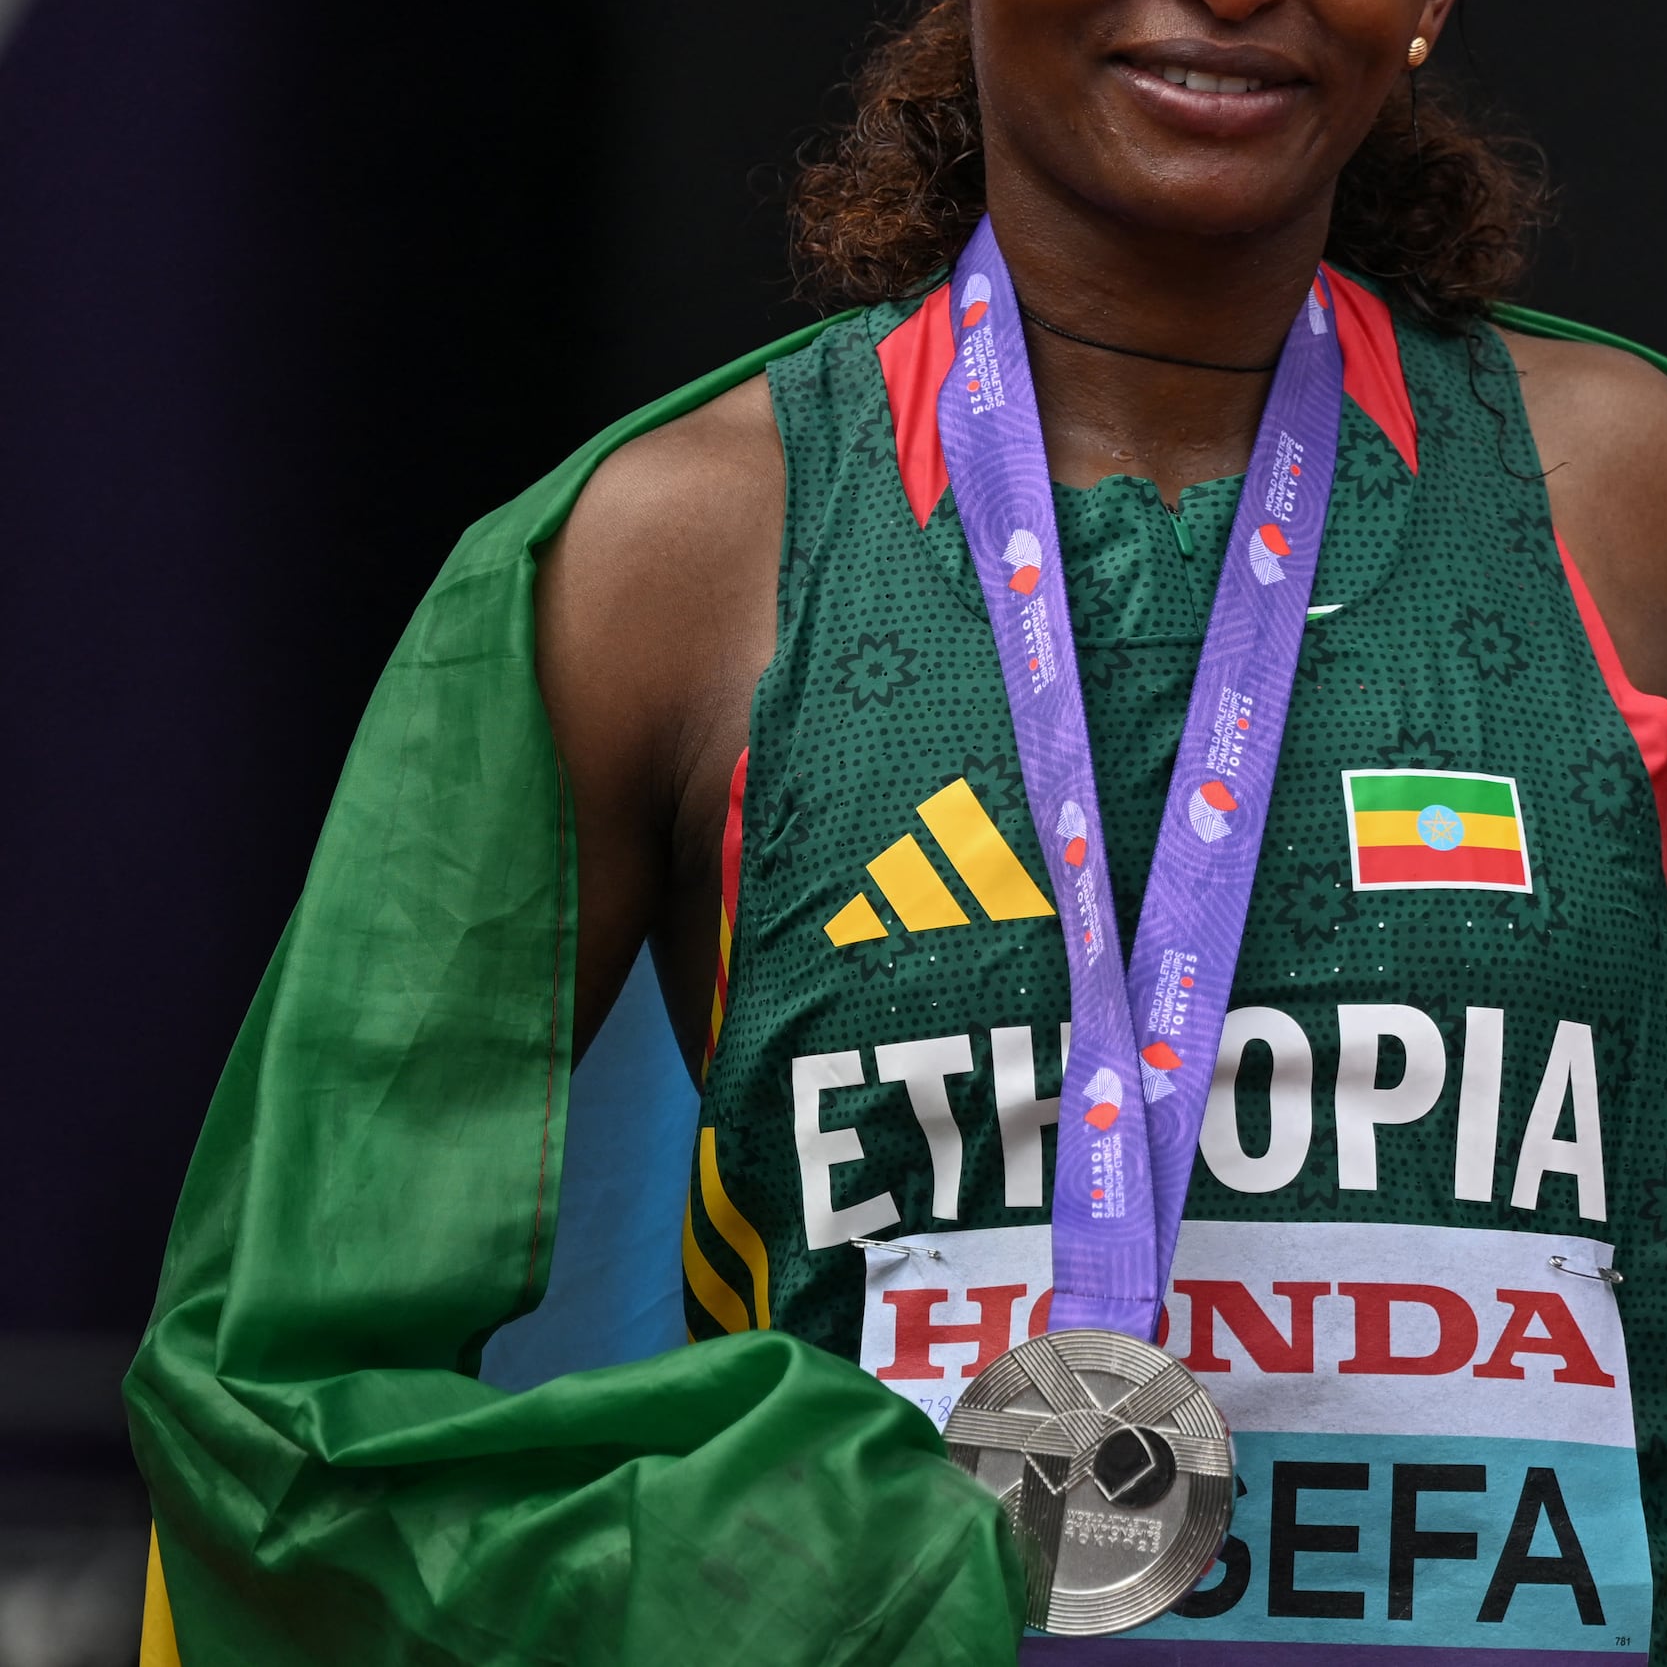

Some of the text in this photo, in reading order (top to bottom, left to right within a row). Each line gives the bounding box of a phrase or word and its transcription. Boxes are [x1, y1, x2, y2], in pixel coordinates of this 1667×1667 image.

[972, 330, 994, 411] CHAMPIONSHIPS
[982, 324, 1005, 407] WORLD ATHLETICS
[1264, 430, 1288, 512] WORLD ATHLETICS
[1272, 437, 1295, 518] CHAMPIONSHIPS
[1206, 686, 1232, 769] WORLD ATHLETICS
[1216, 692, 1242, 774] CHAMPIONSHIPS
[1147, 948, 1174, 1032] WORLD ATHLETICS
[1158, 952, 1184, 1034] CHAMPIONSHIPS
[792, 1003, 1608, 1251] ETHOPIA
[1615, 1636, 1631, 1646] 781
